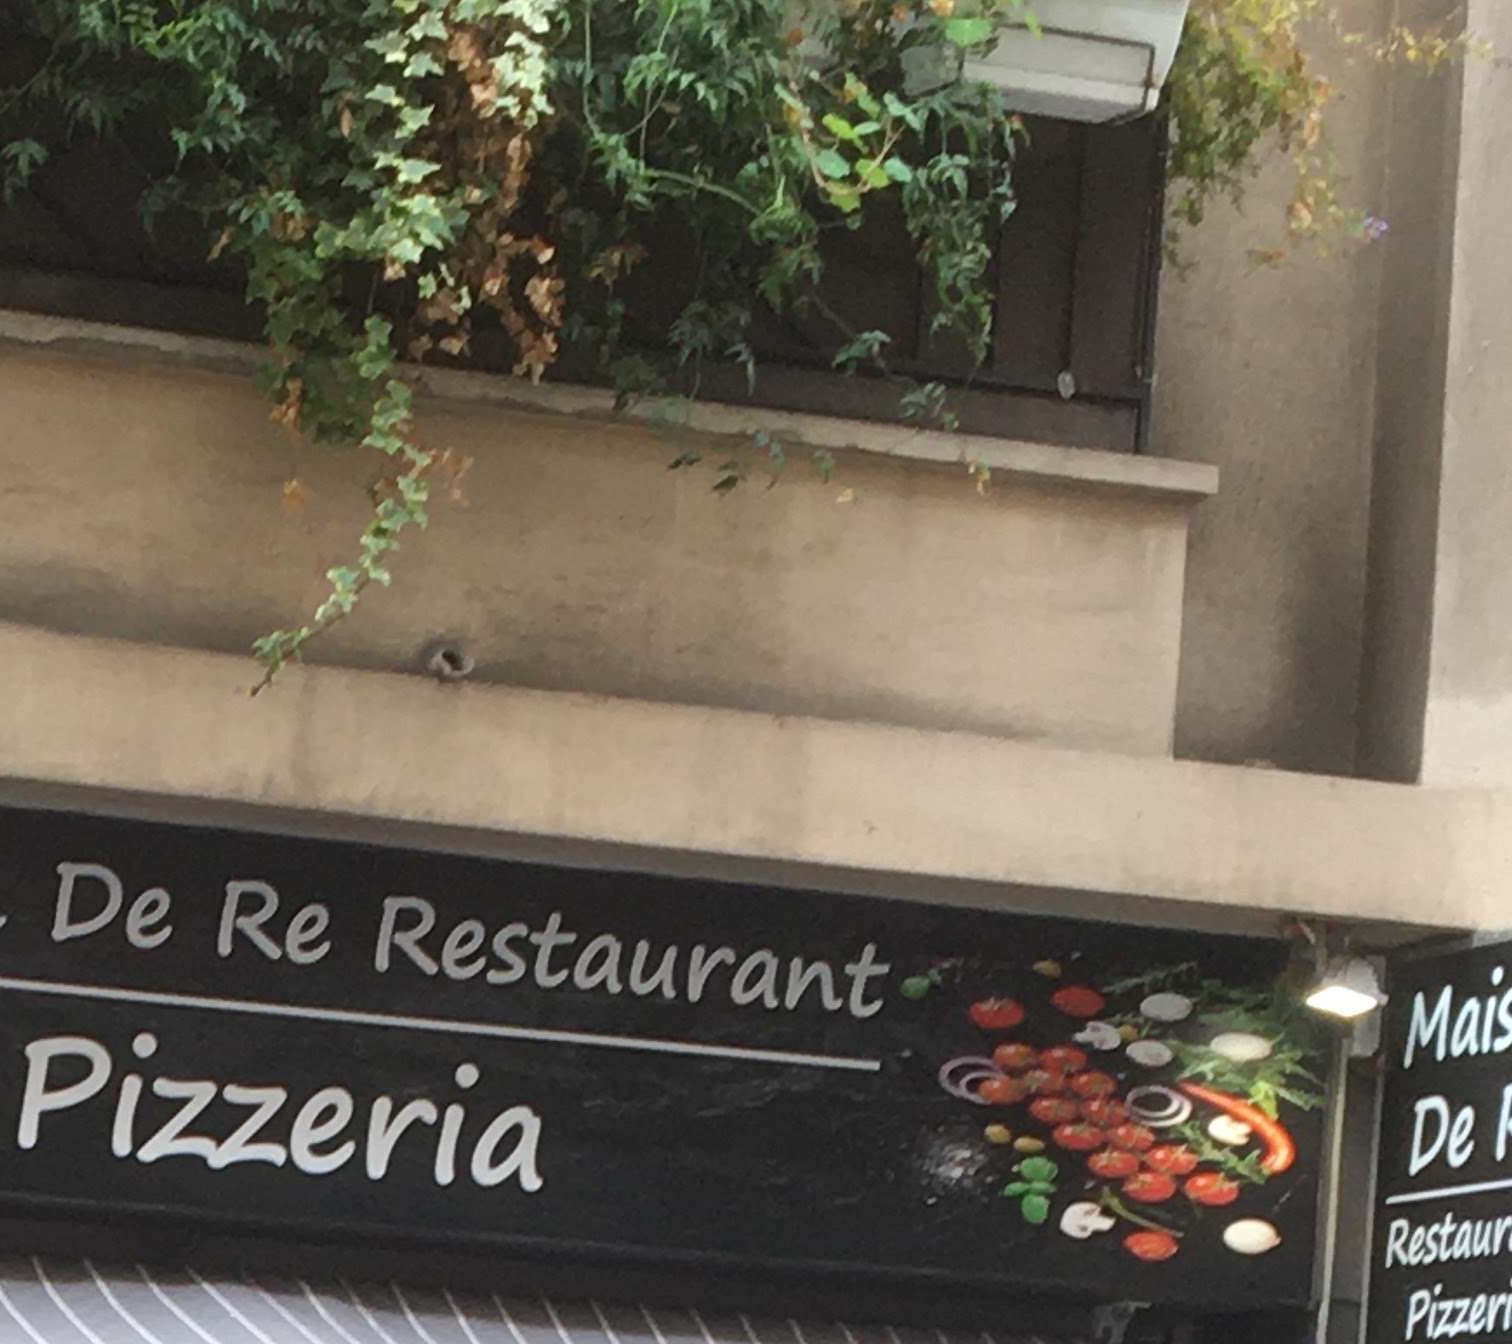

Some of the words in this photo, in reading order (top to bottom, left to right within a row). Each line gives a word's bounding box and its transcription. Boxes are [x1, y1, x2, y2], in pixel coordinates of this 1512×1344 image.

[49, 861, 173, 950] De
[216, 880, 334, 965] Re
[371, 896, 890, 1019] Restaurant
[16, 1033, 545, 1194] Pizzeria
[1408, 1094, 1475, 1177] De
